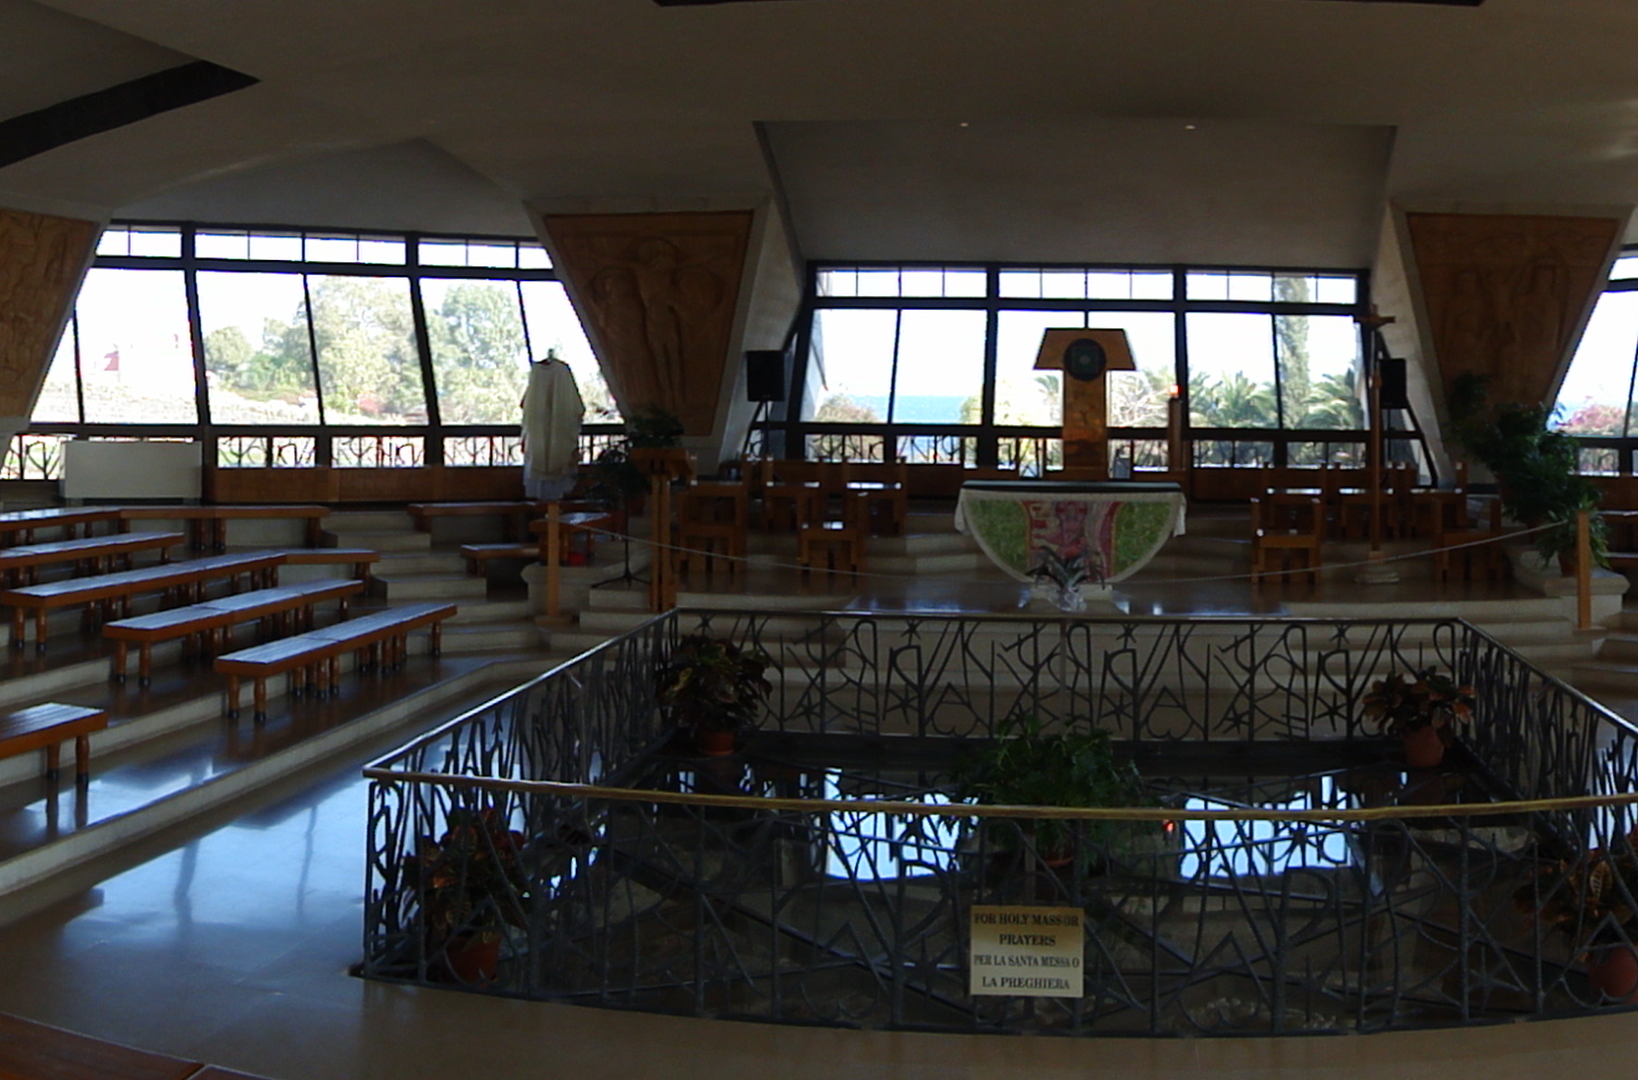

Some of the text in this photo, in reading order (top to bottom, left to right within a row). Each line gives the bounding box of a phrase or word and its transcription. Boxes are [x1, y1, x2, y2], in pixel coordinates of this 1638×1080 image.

[974, 913, 1079, 927] FOR HOLY MASS OR
[999, 933, 1056, 946] PRAYERS
[974, 954, 1080, 968] PER LA SANTA MESSA O
[982, 976, 1070, 990] LA PREGHIERA
